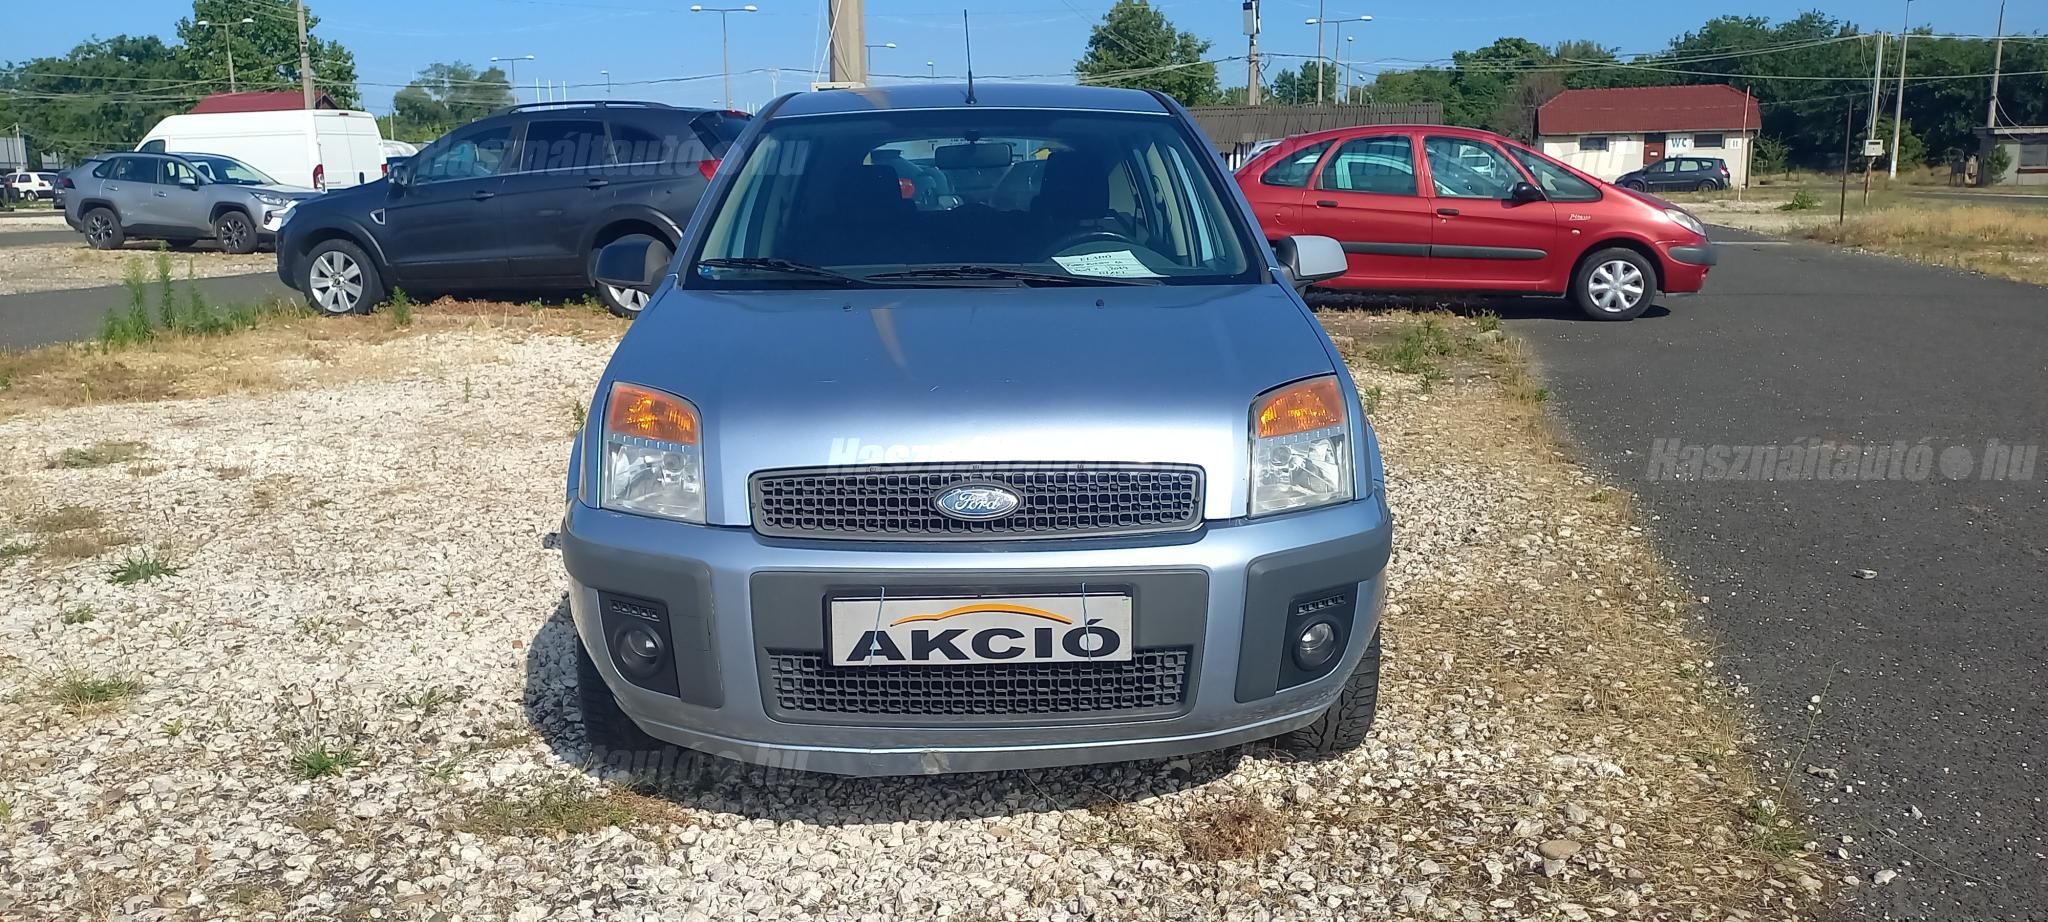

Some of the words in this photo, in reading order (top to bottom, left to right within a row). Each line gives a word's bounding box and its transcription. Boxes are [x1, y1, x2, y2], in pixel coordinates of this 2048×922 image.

[1671, 138, 1687, 148] WC
[954, 491, 1001, 510] Ford
[846, 618, 1121, 662] AKCIÓ
